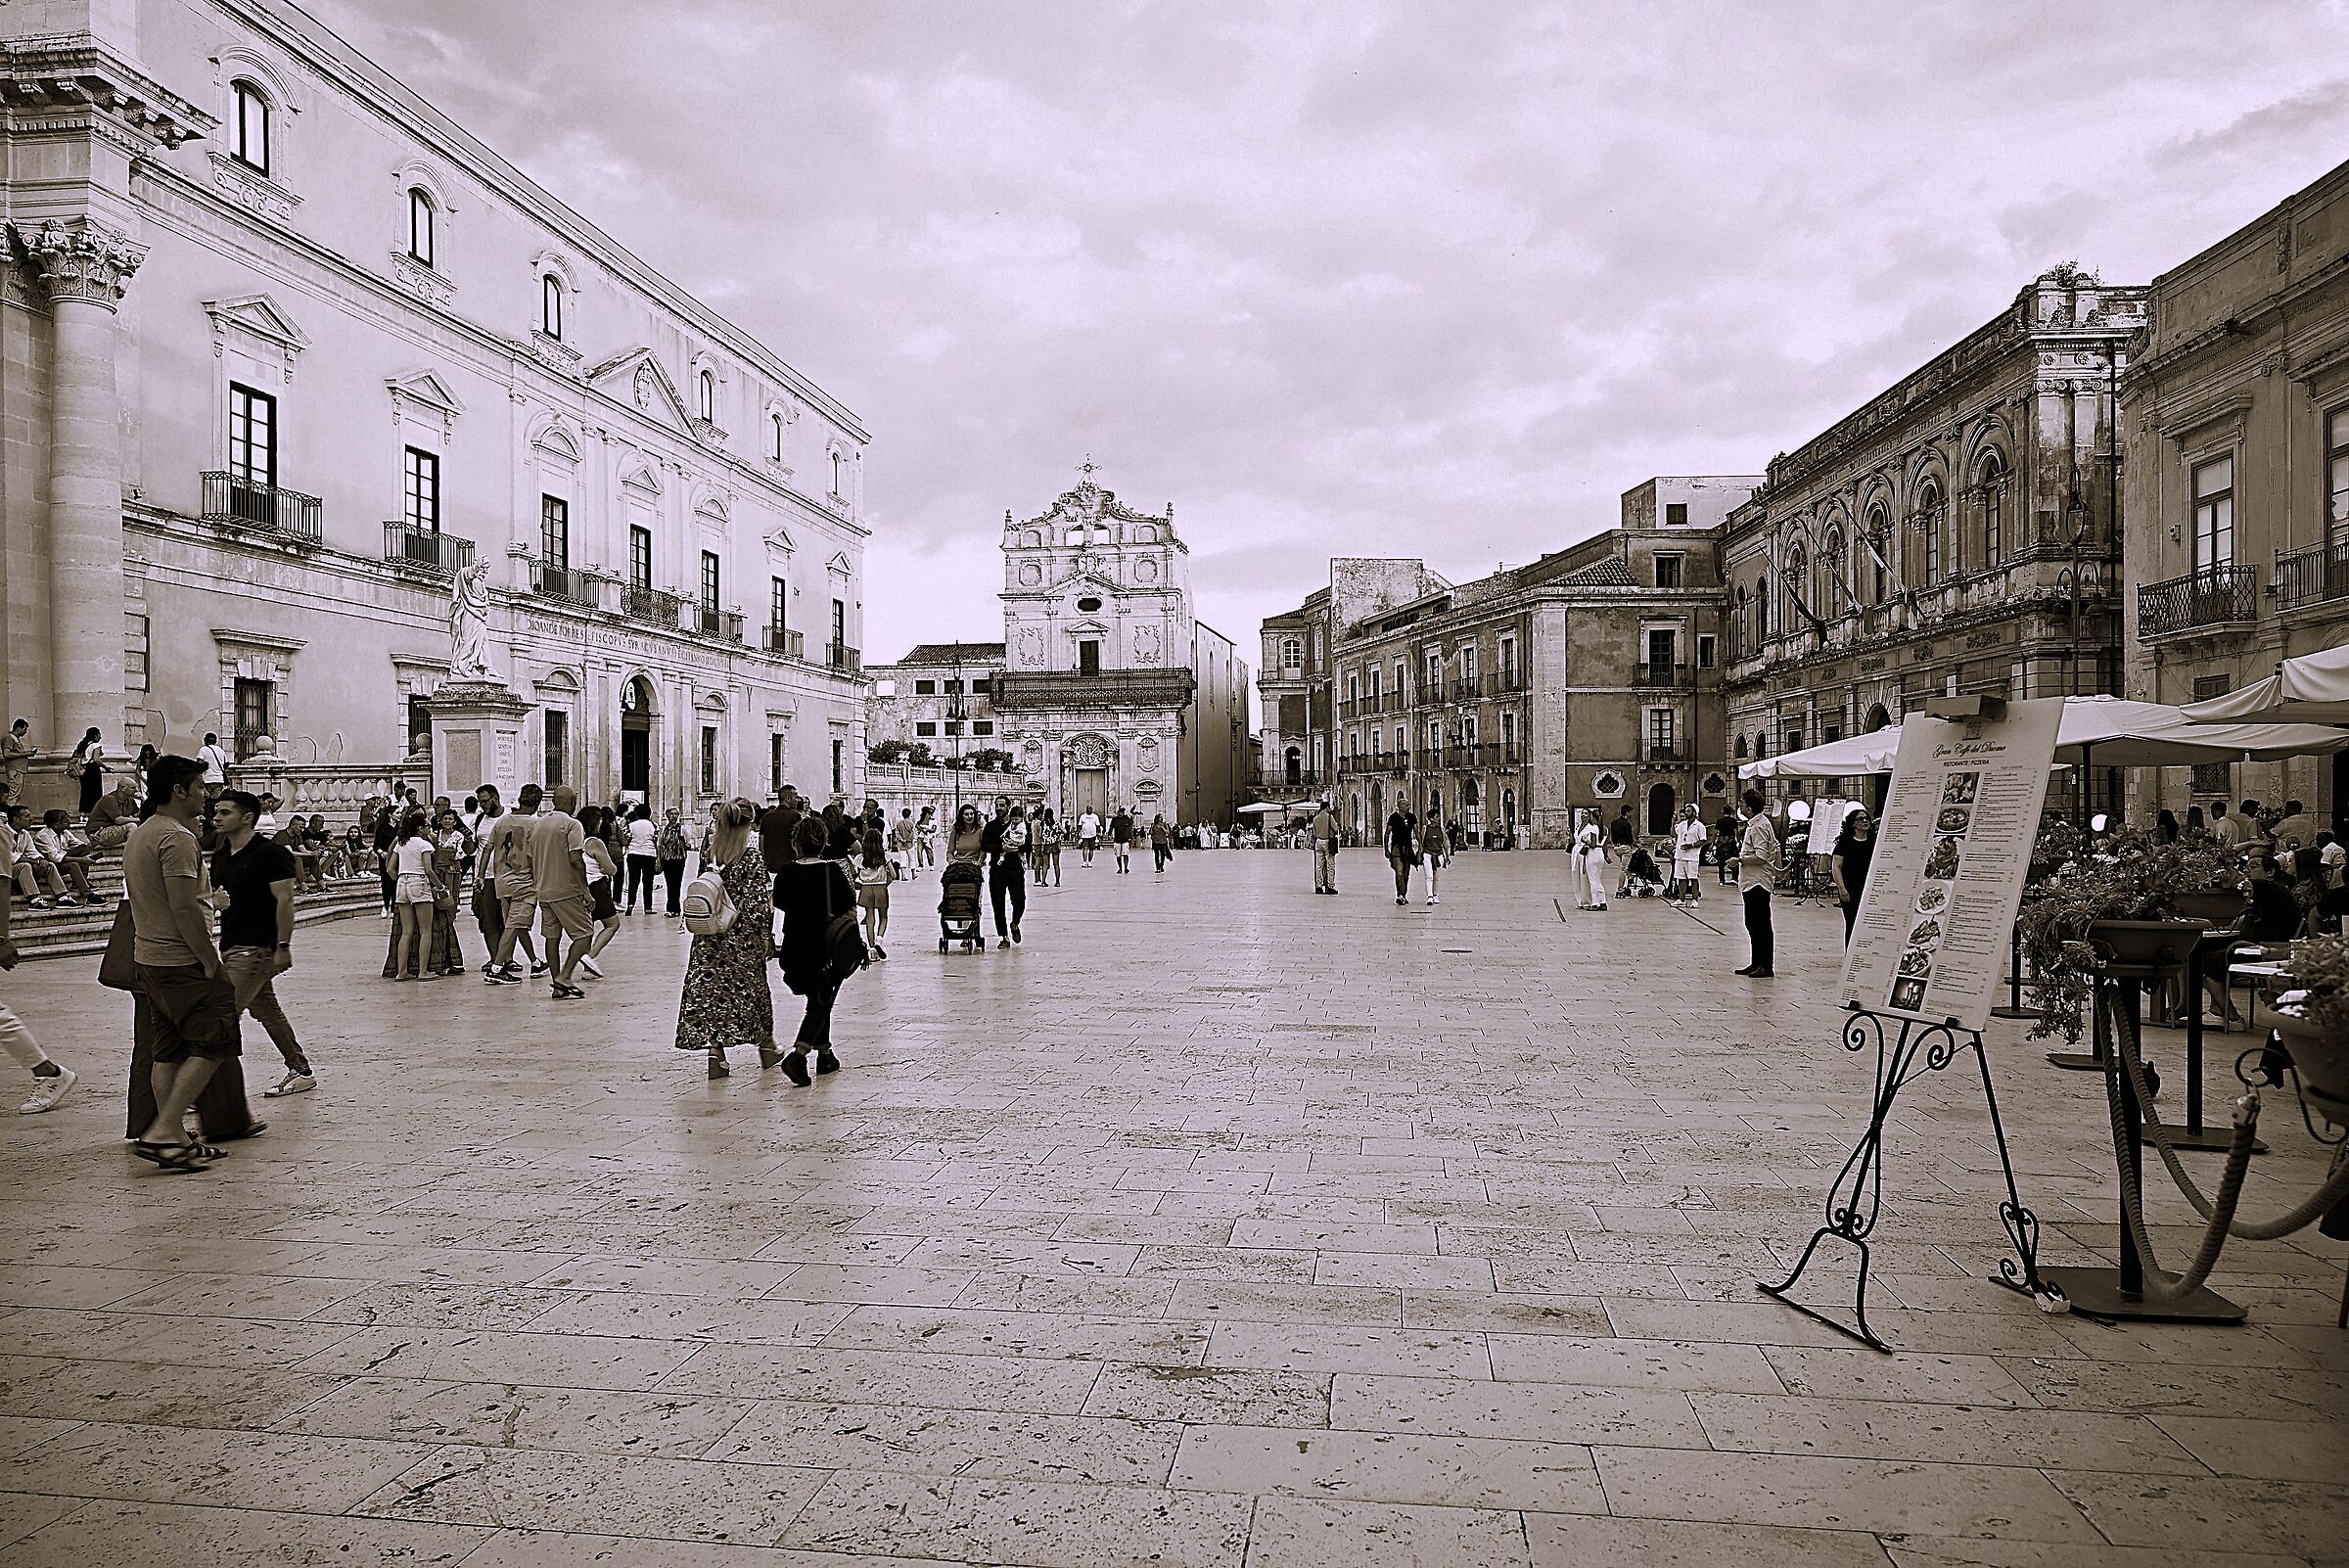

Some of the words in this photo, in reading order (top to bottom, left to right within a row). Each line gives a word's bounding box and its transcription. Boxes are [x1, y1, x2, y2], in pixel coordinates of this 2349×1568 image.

[1933, 744, 1952, 758] Gran
[1971, 744, 1982, 753] del
[1980, 741, 2005, 753] Duomo
